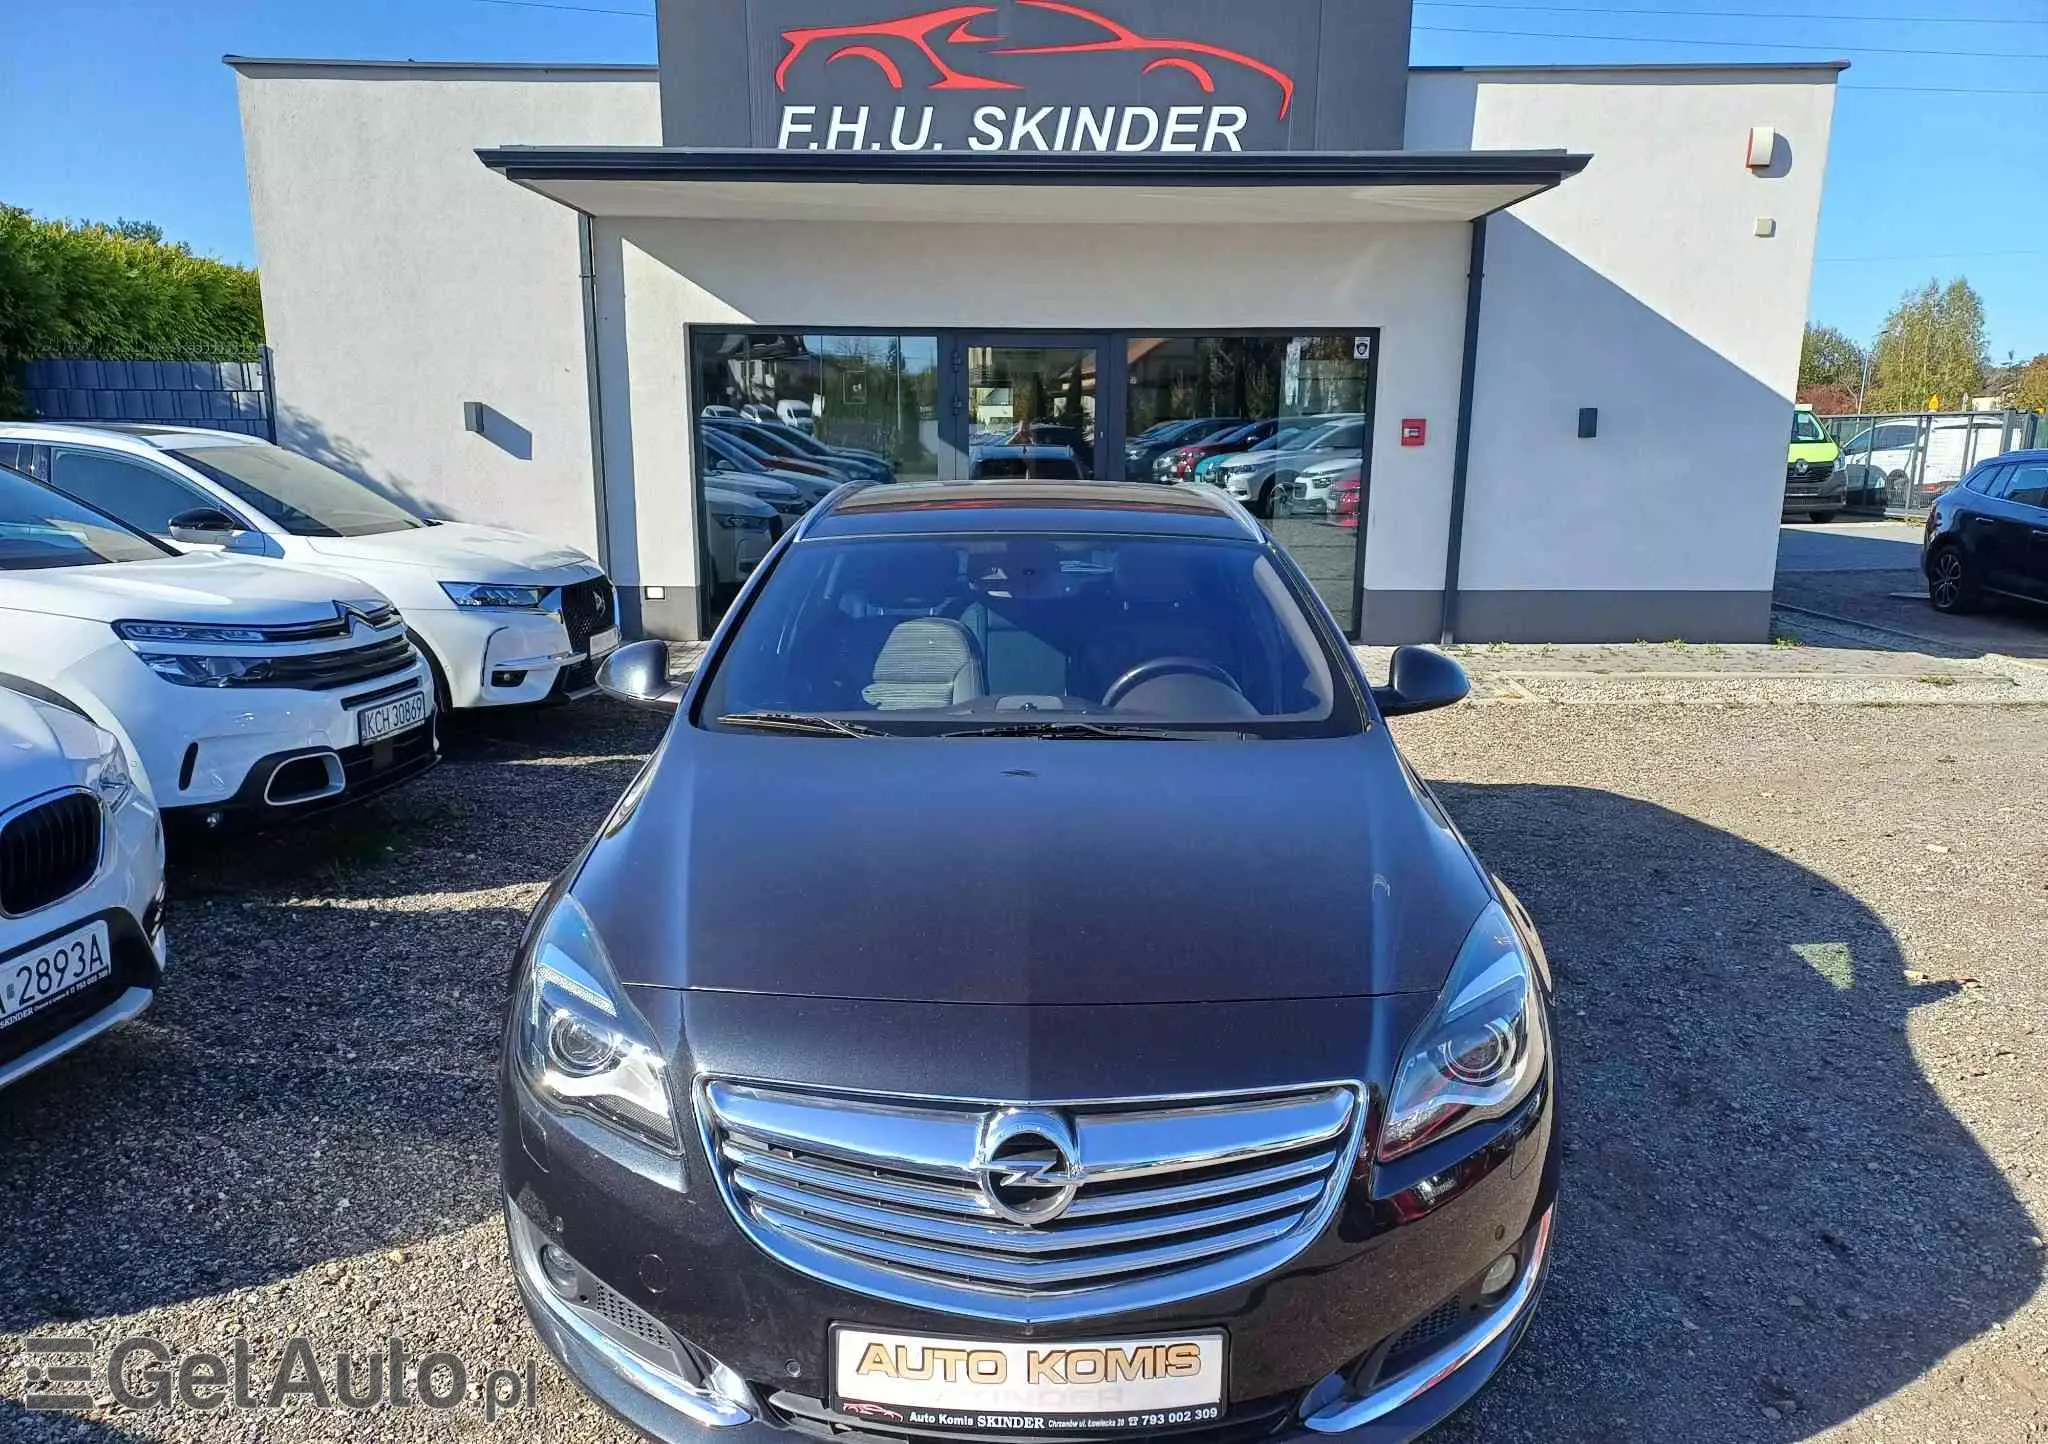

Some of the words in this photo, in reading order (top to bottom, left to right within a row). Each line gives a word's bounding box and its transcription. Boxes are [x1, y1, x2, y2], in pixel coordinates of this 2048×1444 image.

[777, 105, 944, 152] F.H.U.
[967, 105, 1248, 153] SKINDER
[367, 704, 390, 736] KCH
[392, 697, 422, 727] 30869
[16, 934, 103, 1006] 2893A
[856, 1342, 1008, 1384] AUTO
[1027, 1342, 1201, 1385] KOMIS
[909, 1411, 936, 1423] Auto
[939, 1414, 973, 1426] Komis
[977, 1415, 1045, 1429] SKINDER
[1141, 1415, 1165, 1426] 793
[1168, 1411, 1191, 1423] 002
[1195, 1407, 1218, 1420] 309
